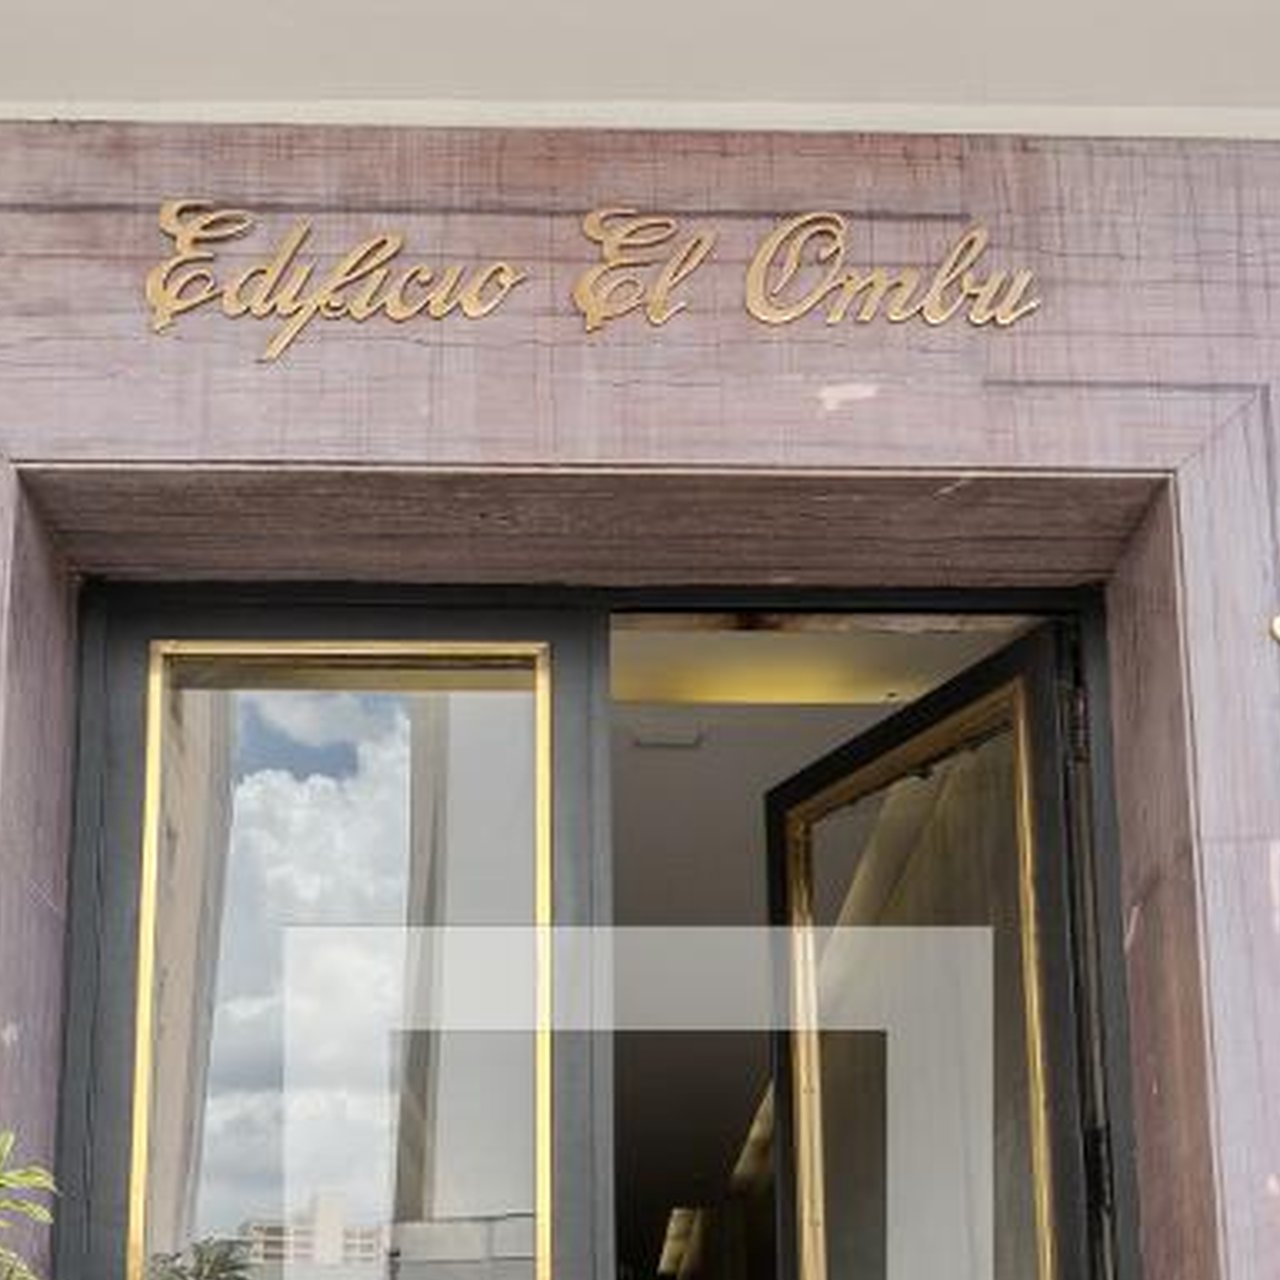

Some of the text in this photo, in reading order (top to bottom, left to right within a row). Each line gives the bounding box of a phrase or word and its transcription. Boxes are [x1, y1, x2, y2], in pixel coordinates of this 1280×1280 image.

[146, 199, 1040, 363] Edificio El Ombu
